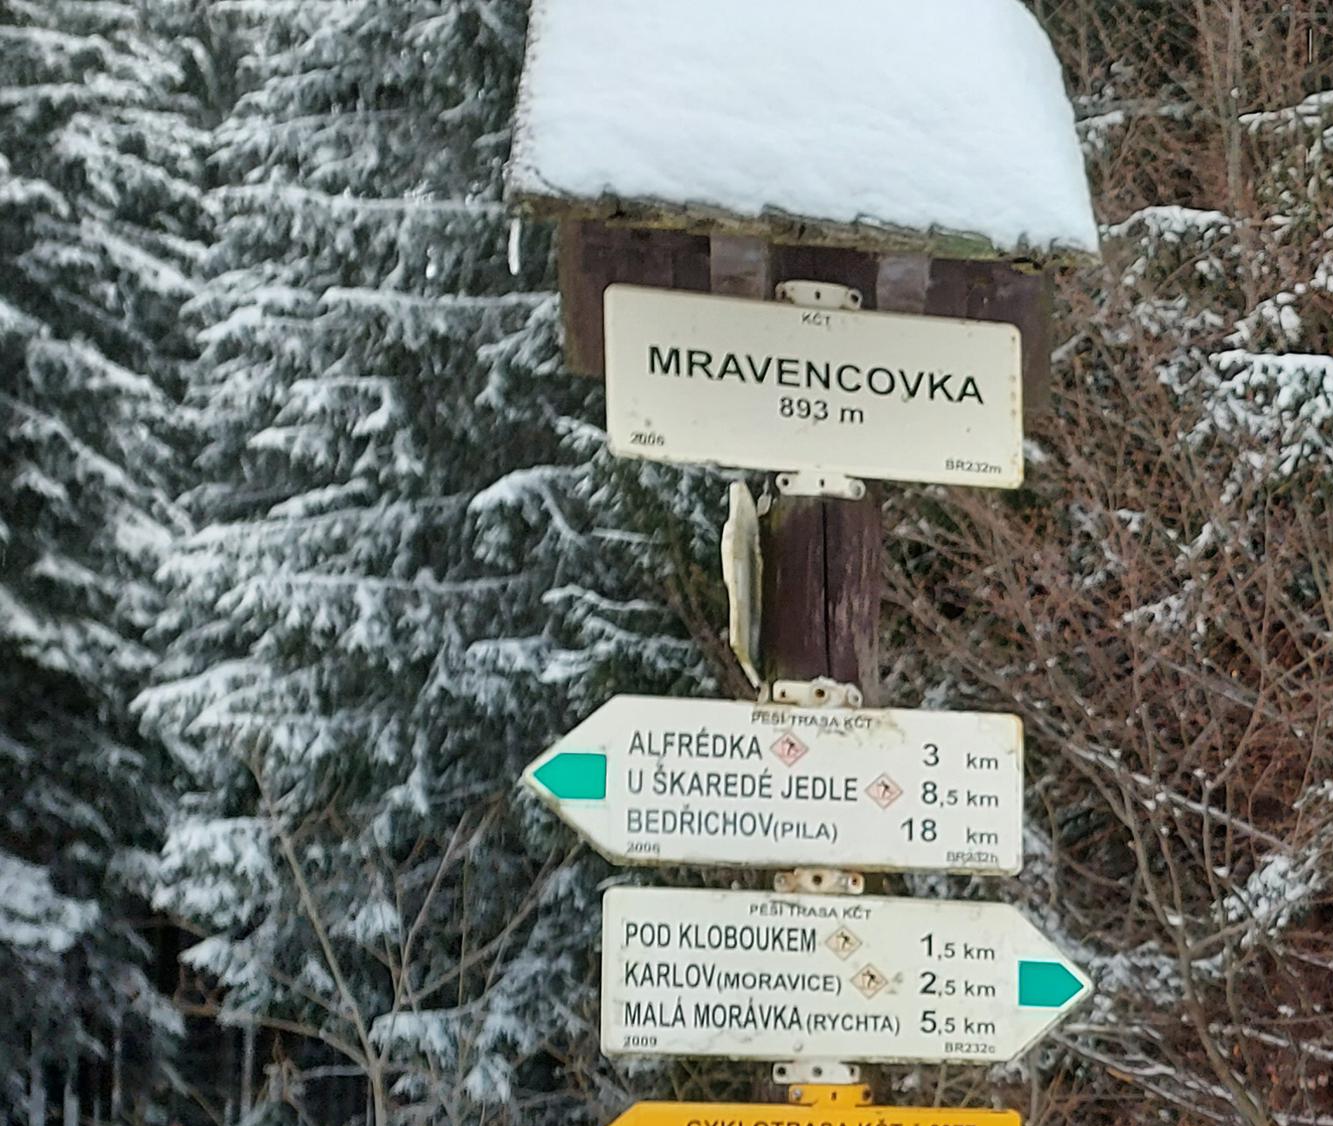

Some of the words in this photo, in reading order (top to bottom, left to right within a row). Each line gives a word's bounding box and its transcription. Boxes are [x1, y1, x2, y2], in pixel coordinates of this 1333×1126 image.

[648, 345, 984, 405] MRAVENCOVKA
[779, 398, 829, 422] 893
[839, 407, 864, 424] m
[628, 727, 762, 760] ALFRÉDKA
[923, 744, 940, 767] 3
[966, 753, 999, 770] km
[628, 770, 644, 794] U
[653, 765, 772, 799] ŠKAREDÉ
[781, 777, 858, 802] JEDLE
[966, 791, 999, 808] km
[900, 819, 938, 843] 18
[966, 828, 999, 845] km
[625, 922, 671, 948] POD
[679, 925, 817, 953] KLOBOUKEM
[920, 933, 956, 961] 1,5
[964, 944, 996, 961] km
[919, 971, 956, 998] 2,5
[964, 980, 996, 998] km
[624, 998, 686, 1028] MALÁ
[919, 1010, 956, 1035] 5,5
[964, 1018, 996, 1035] km
